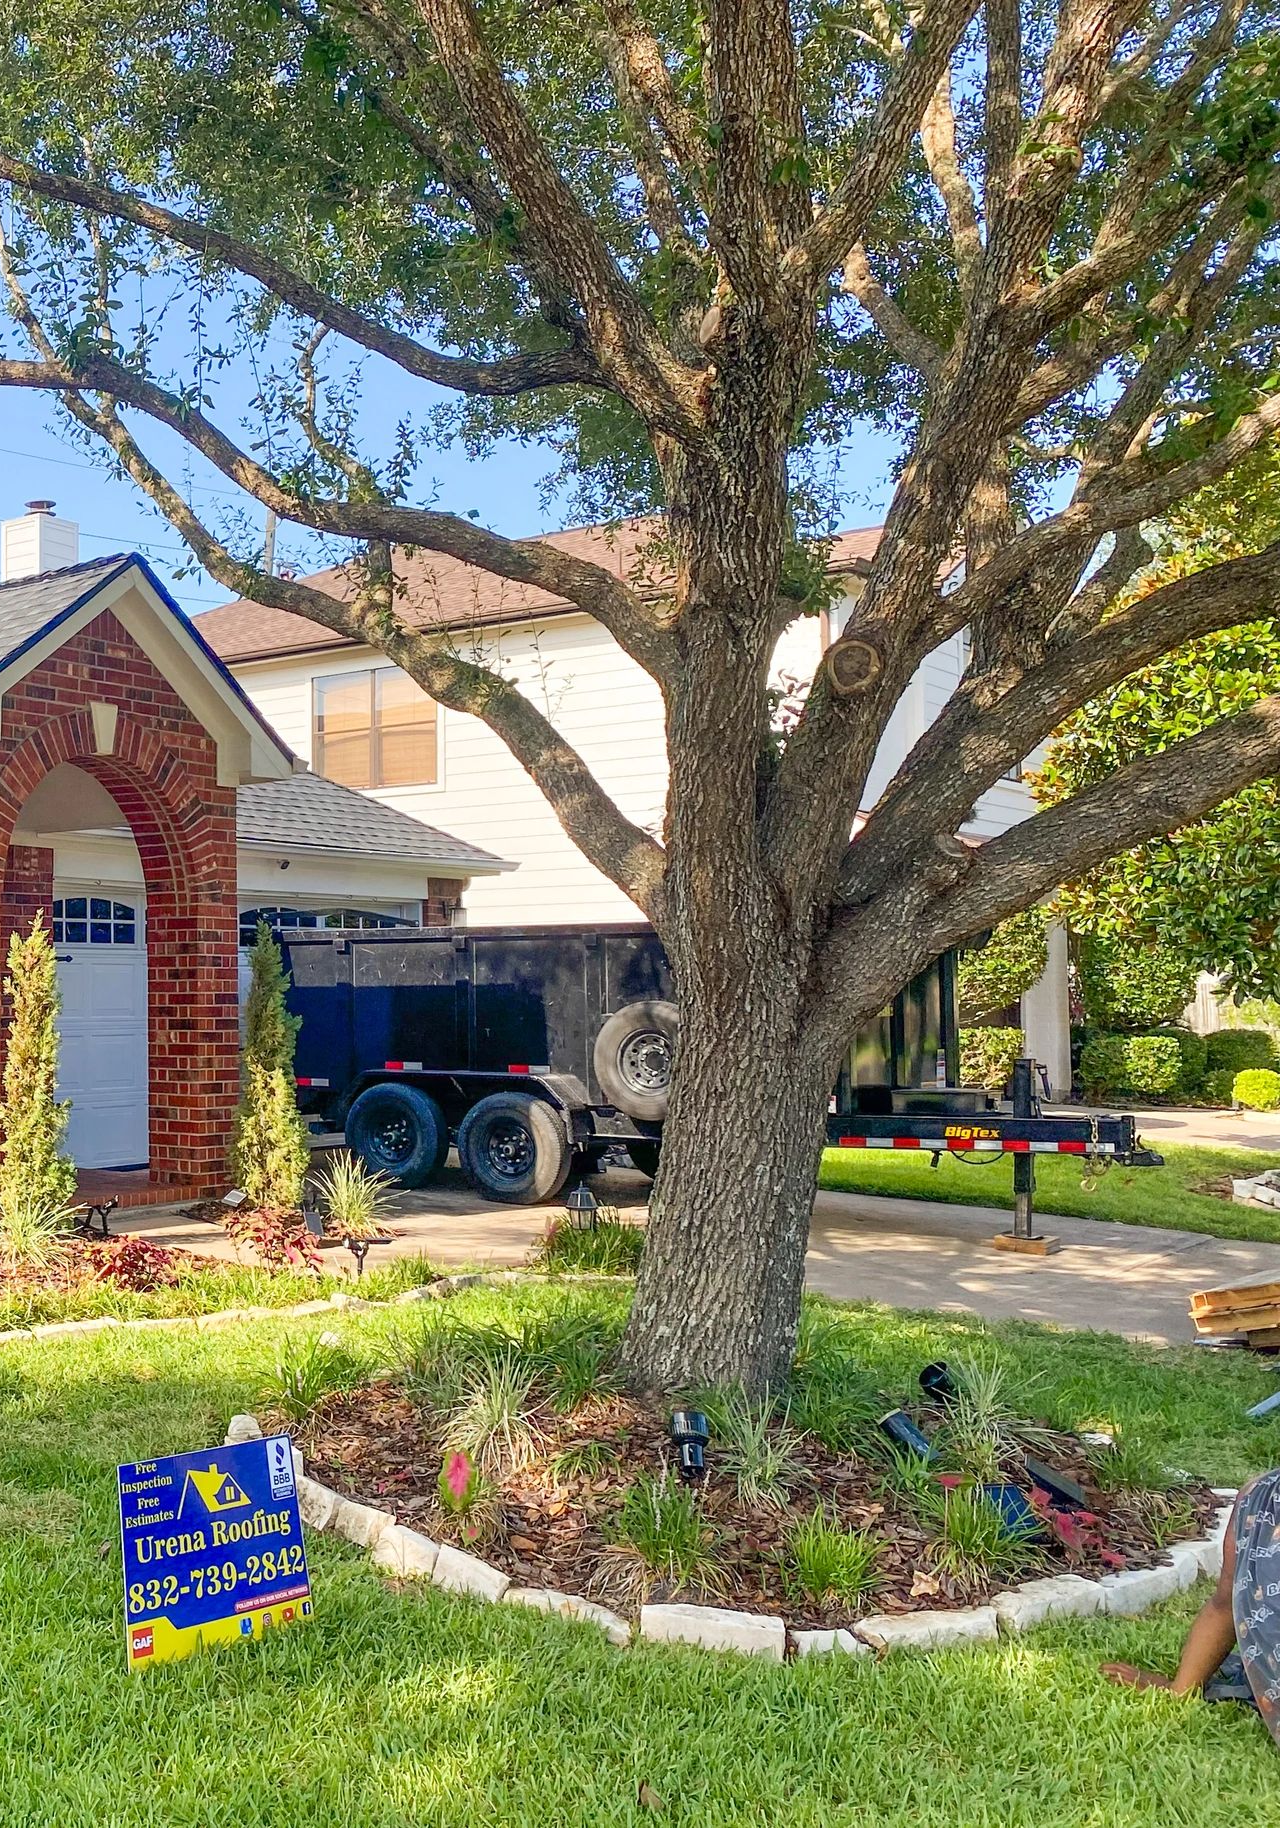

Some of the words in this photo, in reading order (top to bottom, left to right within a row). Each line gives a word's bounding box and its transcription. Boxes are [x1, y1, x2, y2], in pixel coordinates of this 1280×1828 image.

[944, 1126, 1000, 1140] BigTex
[135, 1462, 157, 1475] Free
[121, 1475, 173, 1494] Inspection
[273, 1472, 291, 1486] BBB
[137, 1497, 160, 1510] Free
[125, 1510, 174, 1529] Estimates
[134, 1530, 206, 1564] Urena
[210, 1508, 291, 1547] Roofing
[129, 1545, 304, 1614] 832-739-2842
[133, 1635, 153, 1650] GAF
